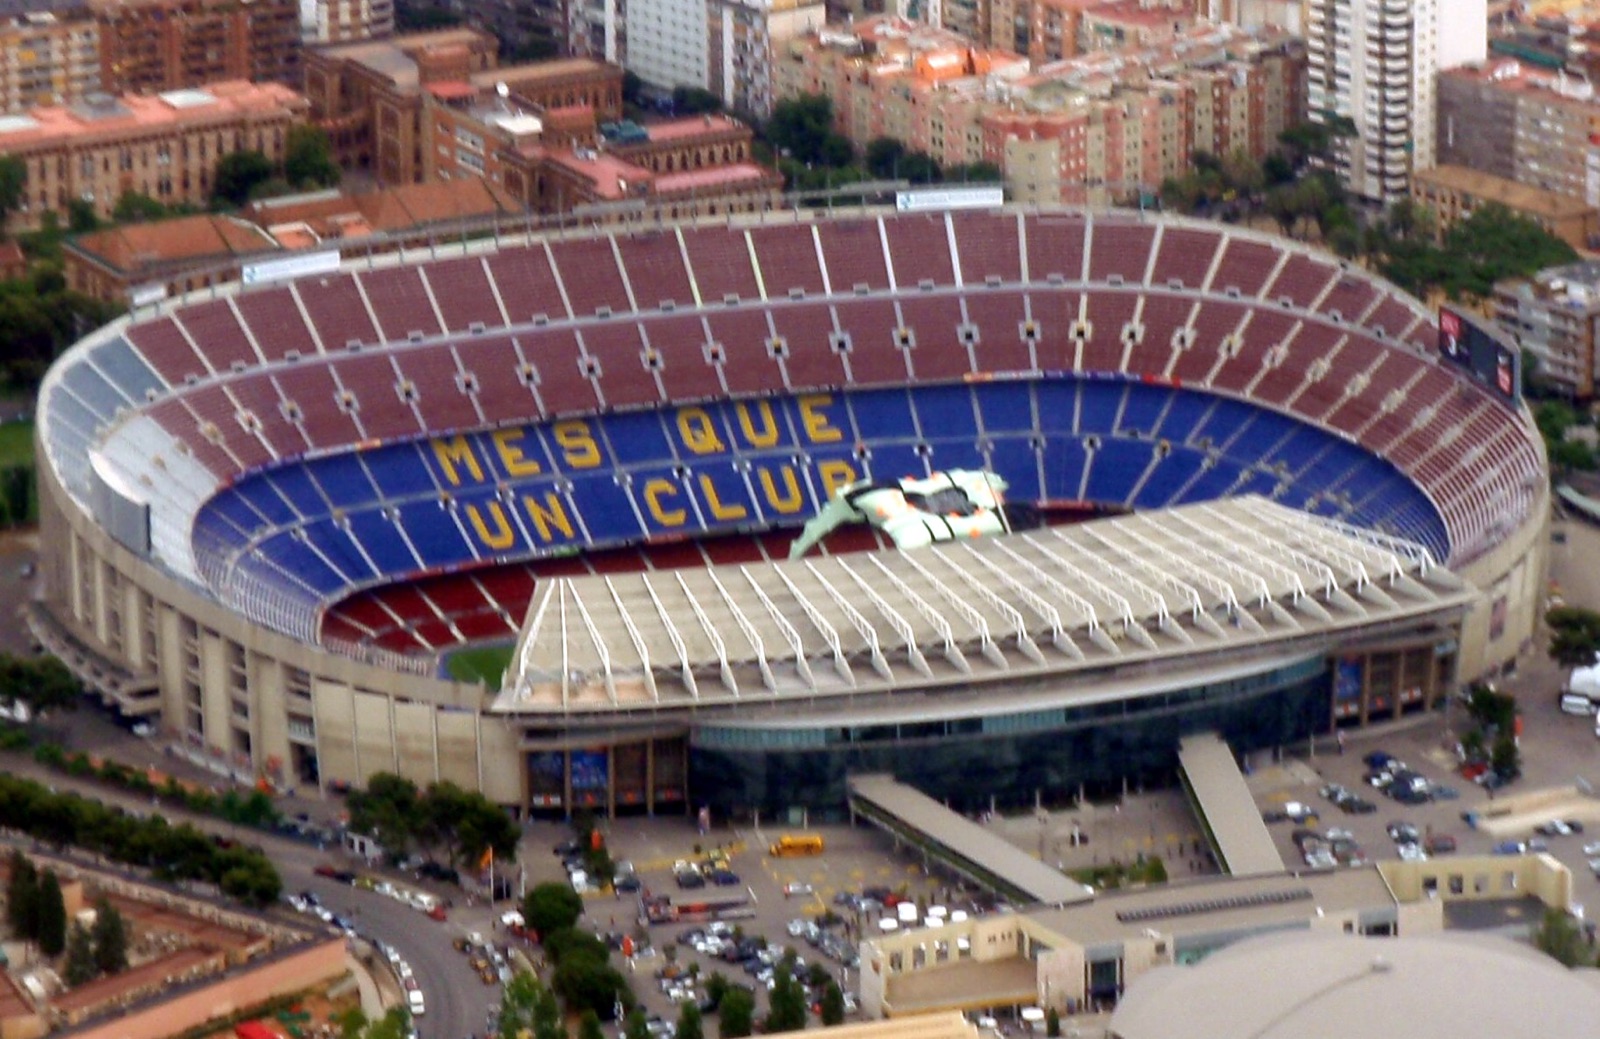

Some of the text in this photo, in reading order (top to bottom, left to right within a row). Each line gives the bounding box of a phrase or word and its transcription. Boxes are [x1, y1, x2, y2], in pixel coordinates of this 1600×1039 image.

[431, 396, 842, 486] MES QUE
[464, 492, 575, 549] UN
